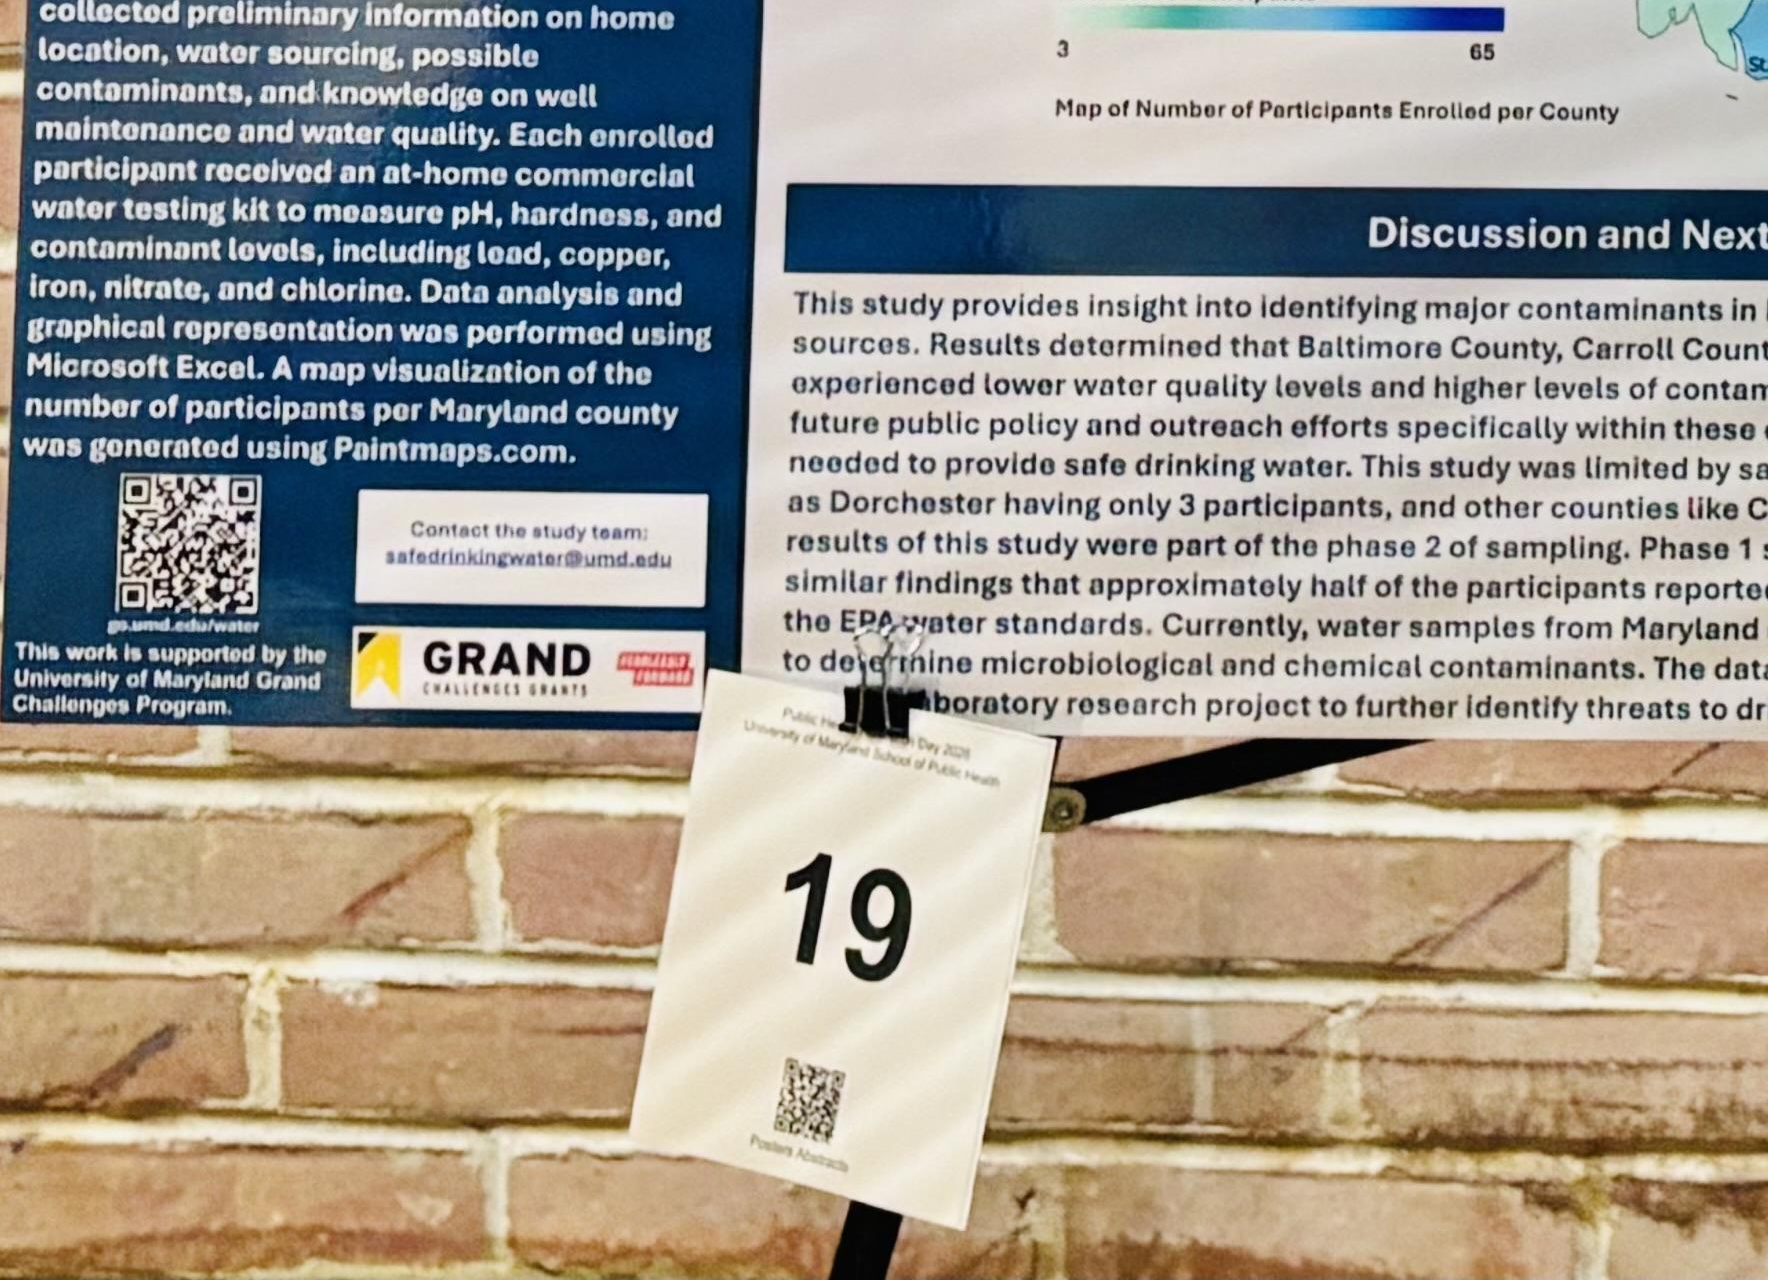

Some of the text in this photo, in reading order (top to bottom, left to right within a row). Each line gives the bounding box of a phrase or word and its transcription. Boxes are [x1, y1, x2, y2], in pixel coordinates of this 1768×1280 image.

[1057, 39, 1070, 58] 3
[1469, 43, 1496, 62] 65
[1368, 215, 1587, 249] Discussion
[1597, 218, 1671, 250] and
[410, 520, 648, 544] Contact the study team:
[386, 548, 673, 569] safedrinkingwater@umd.edu
[423, 640, 592, 677] GRAND
[423, 682, 587, 698] CHALLENGES GRANTS
[784, 852, 913, 982] 19
